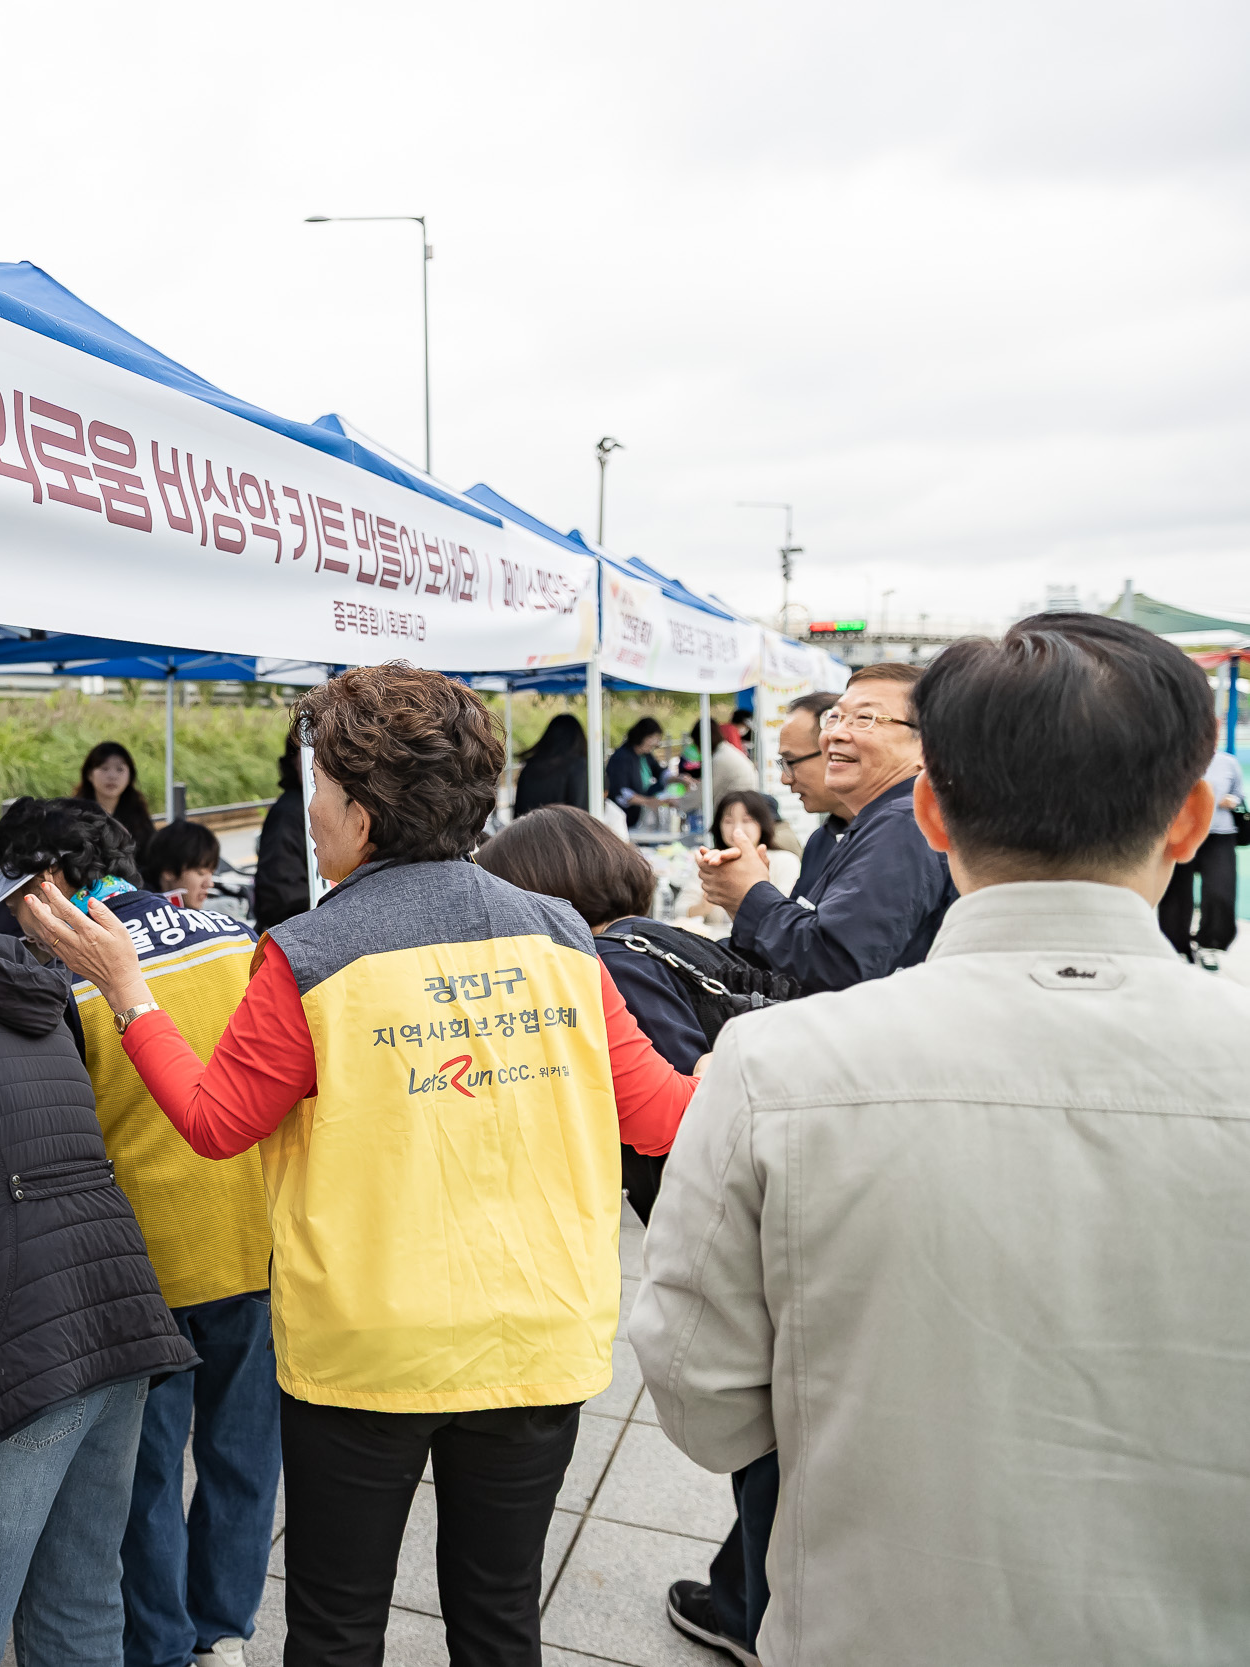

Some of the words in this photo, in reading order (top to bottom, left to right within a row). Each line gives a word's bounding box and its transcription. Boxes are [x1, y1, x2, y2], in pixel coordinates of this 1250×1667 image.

[151, 440, 283, 564] 비상약
[282, 485, 350, 574] 키트
[352, 508, 422, 595] 만들어
[333, 600, 426, 641] 중곡종합사회복지관
[424, 967, 526, 1003] 광진구
